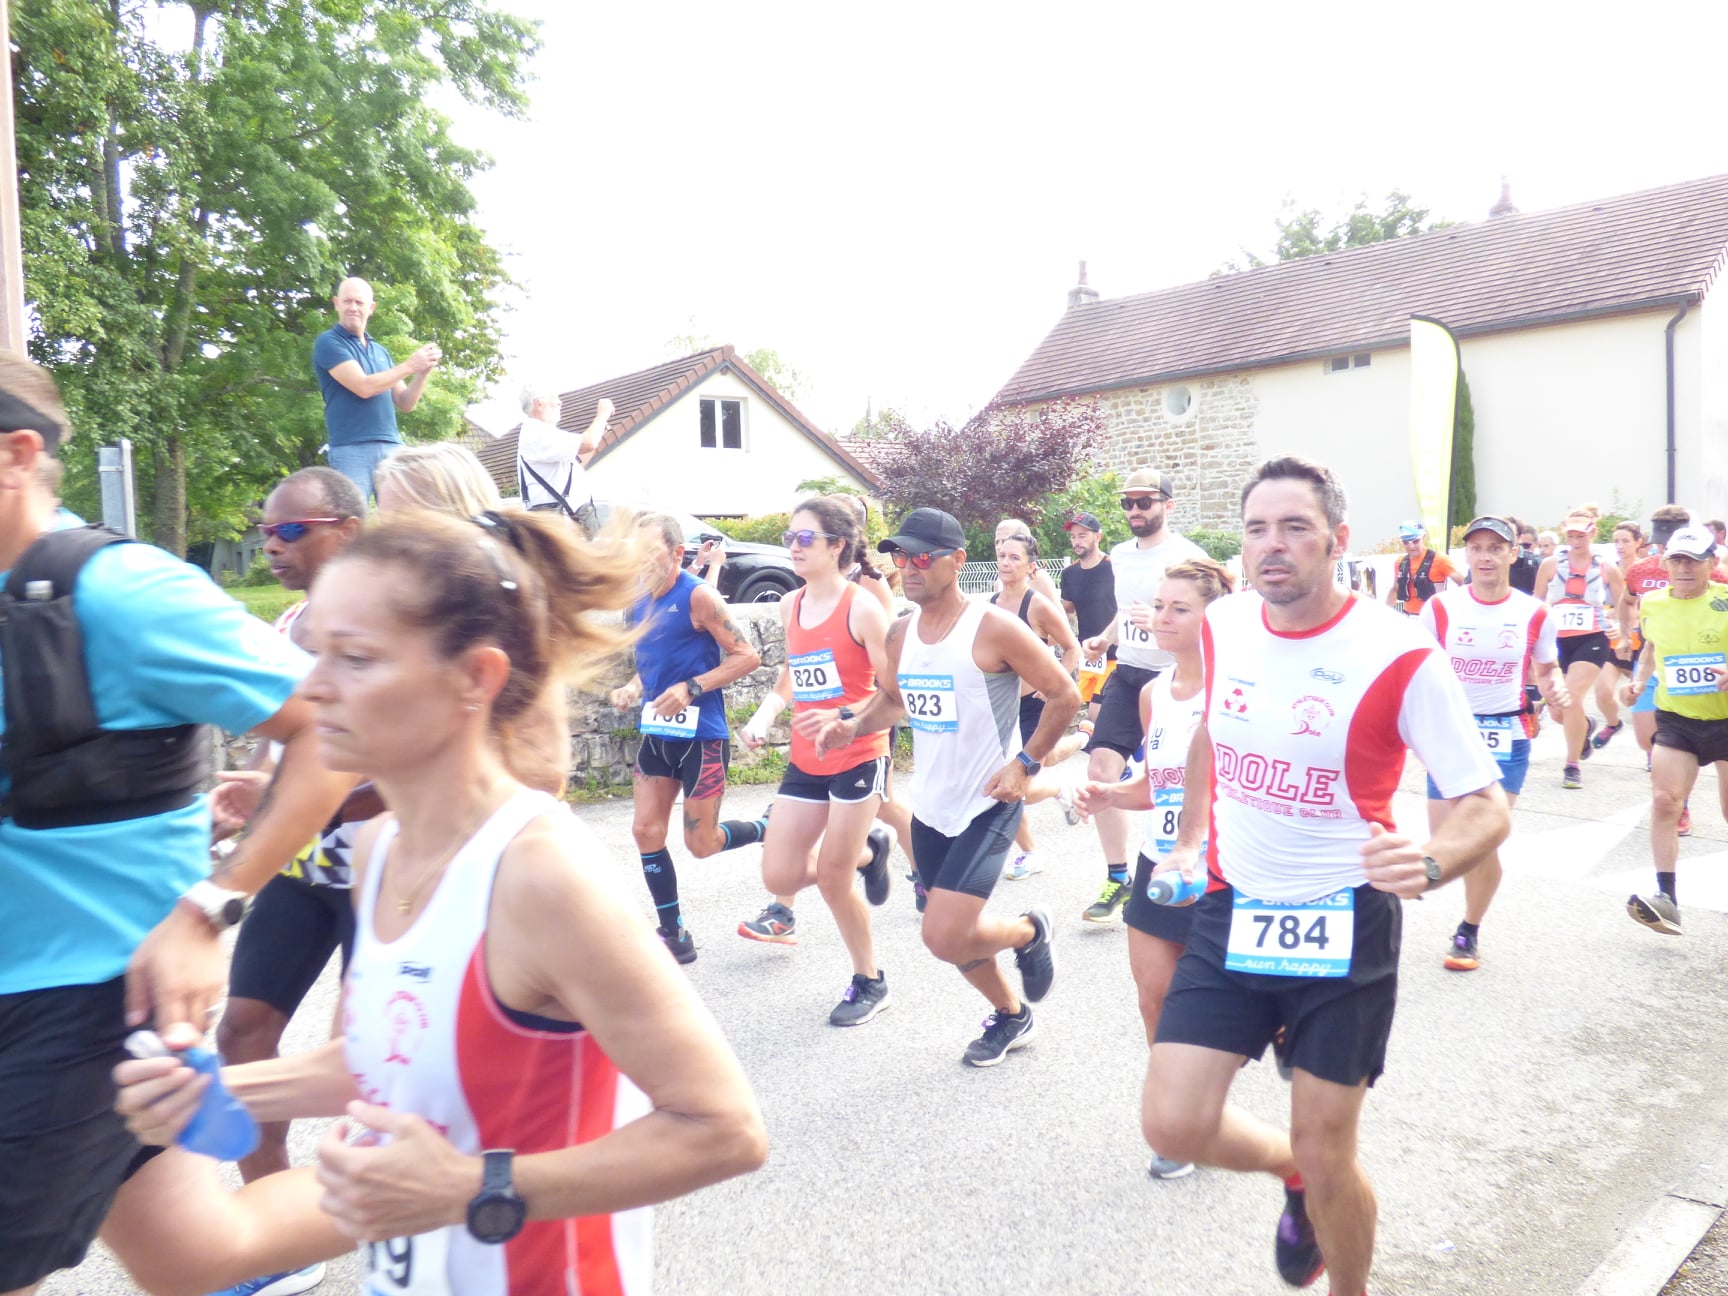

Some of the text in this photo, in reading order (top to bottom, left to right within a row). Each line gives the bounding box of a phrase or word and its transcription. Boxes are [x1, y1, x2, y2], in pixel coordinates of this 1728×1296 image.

[1562, 613, 1584, 626] 175
[1450, 656, 1519, 677] DOLE
[1679, 655, 1724, 665] BROOKS
[794, 667, 827, 687] 820
[908, 678, 952, 688] BROOKS
[1676, 667, 1716, 684] 808
[907, 693, 942, 716] 823
[1215, 742, 1342, 806] DOLE
[1252, 914, 1330, 950] 784
[1243, 958, 1334, 978] run happy
